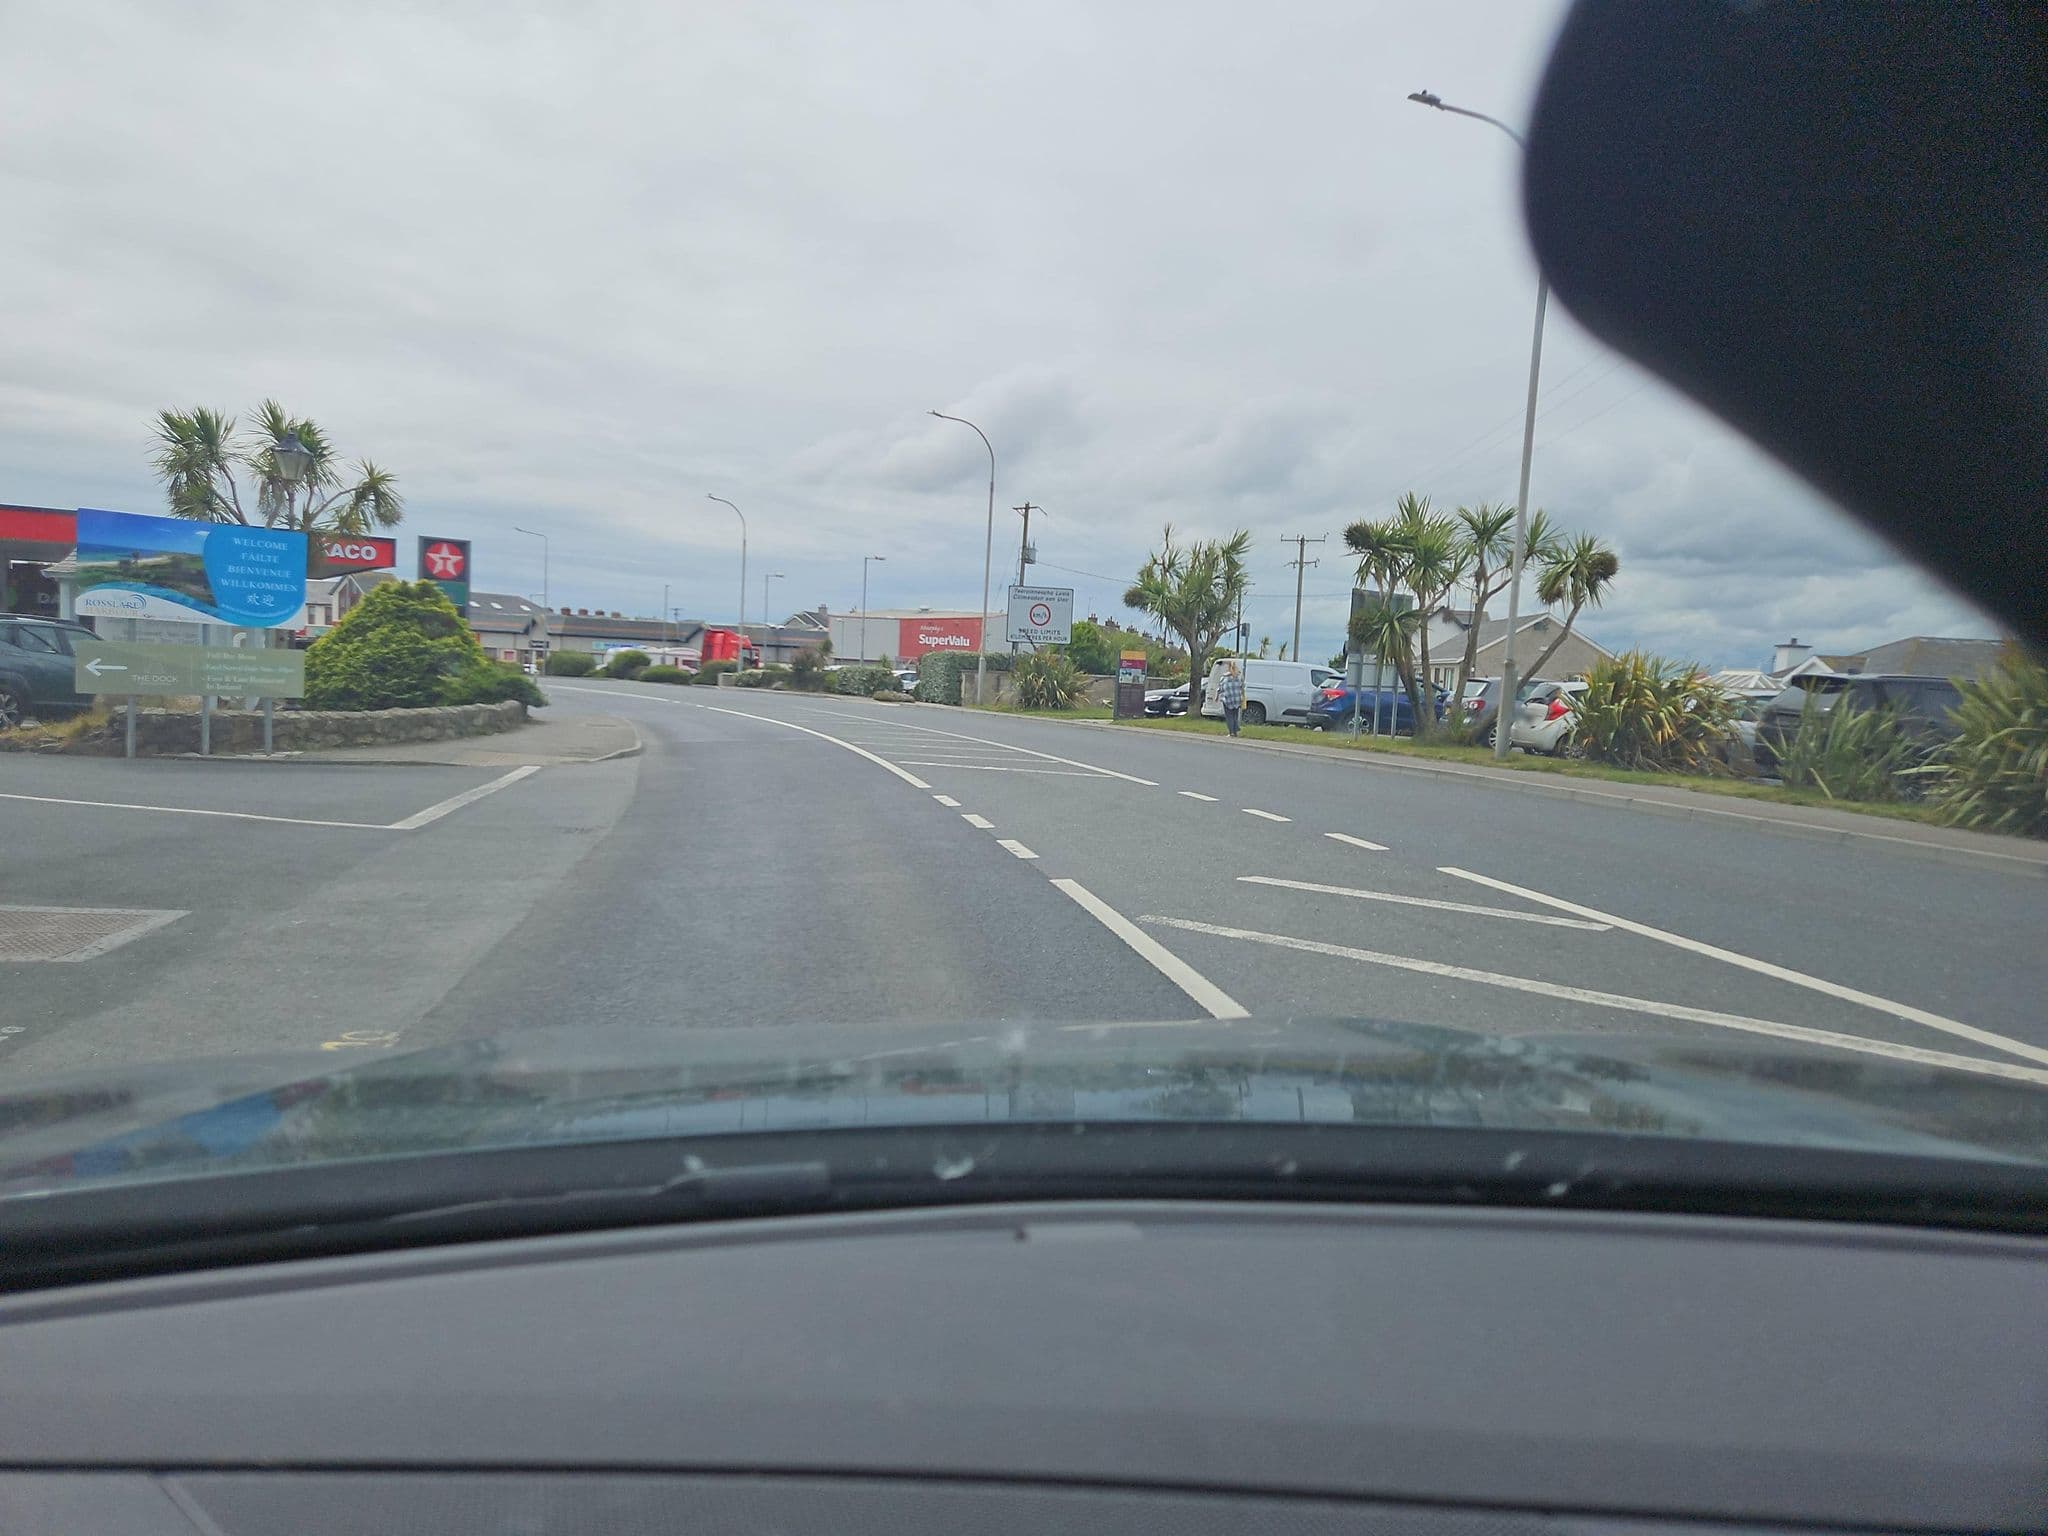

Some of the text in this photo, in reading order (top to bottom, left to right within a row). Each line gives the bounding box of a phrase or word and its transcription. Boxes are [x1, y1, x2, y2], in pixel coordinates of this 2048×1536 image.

[233, 537, 288, 551] WELCOME
[228, 565, 291, 578] BIENVENUE
[221, 578, 298, 592] WILLKOMMEN
[247, 593, 275, 607] 欢迎
[919, 634, 970, 647] SuperValu
[152, 674, 177, 683] DOCK
